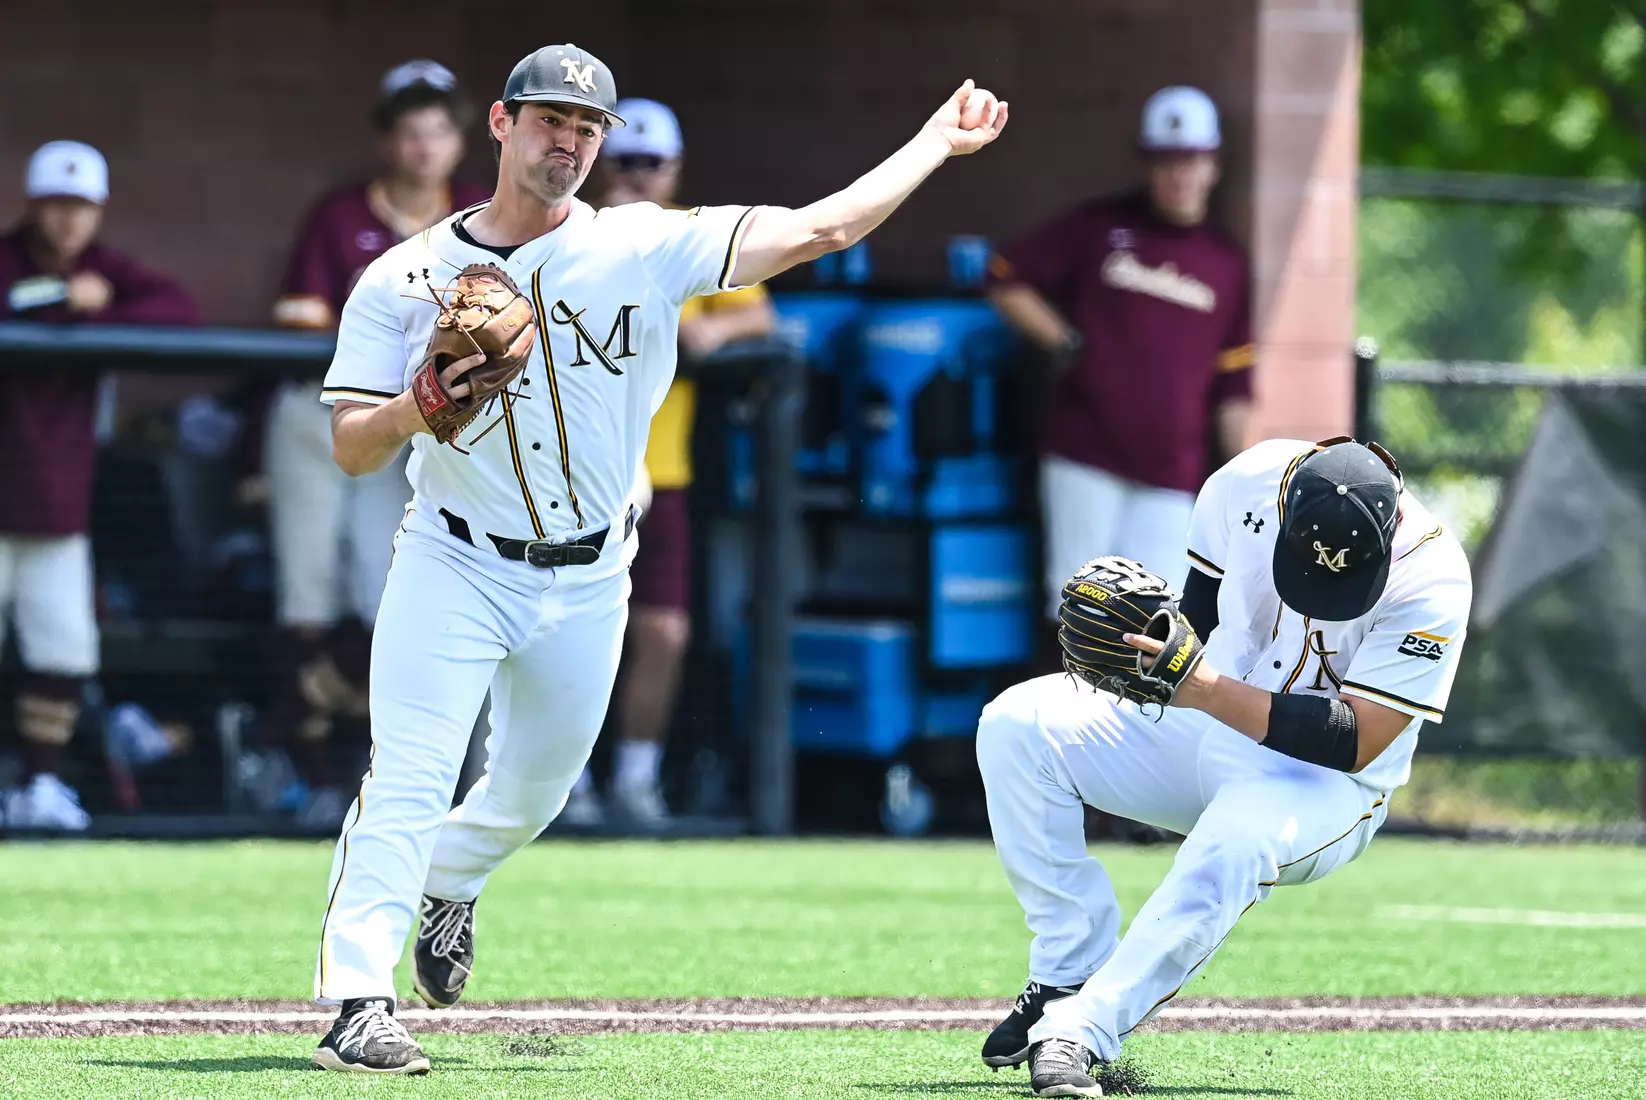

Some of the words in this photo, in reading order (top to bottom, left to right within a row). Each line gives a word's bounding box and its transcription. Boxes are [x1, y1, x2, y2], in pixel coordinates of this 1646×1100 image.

[560, 58, 597, 93] M
[551, 300, 640, 375] M
[1313, 541, 1349, 572] M
[1075, 583, 1108, 600] A2000
[1402, 634, 1448, 655] PSA
